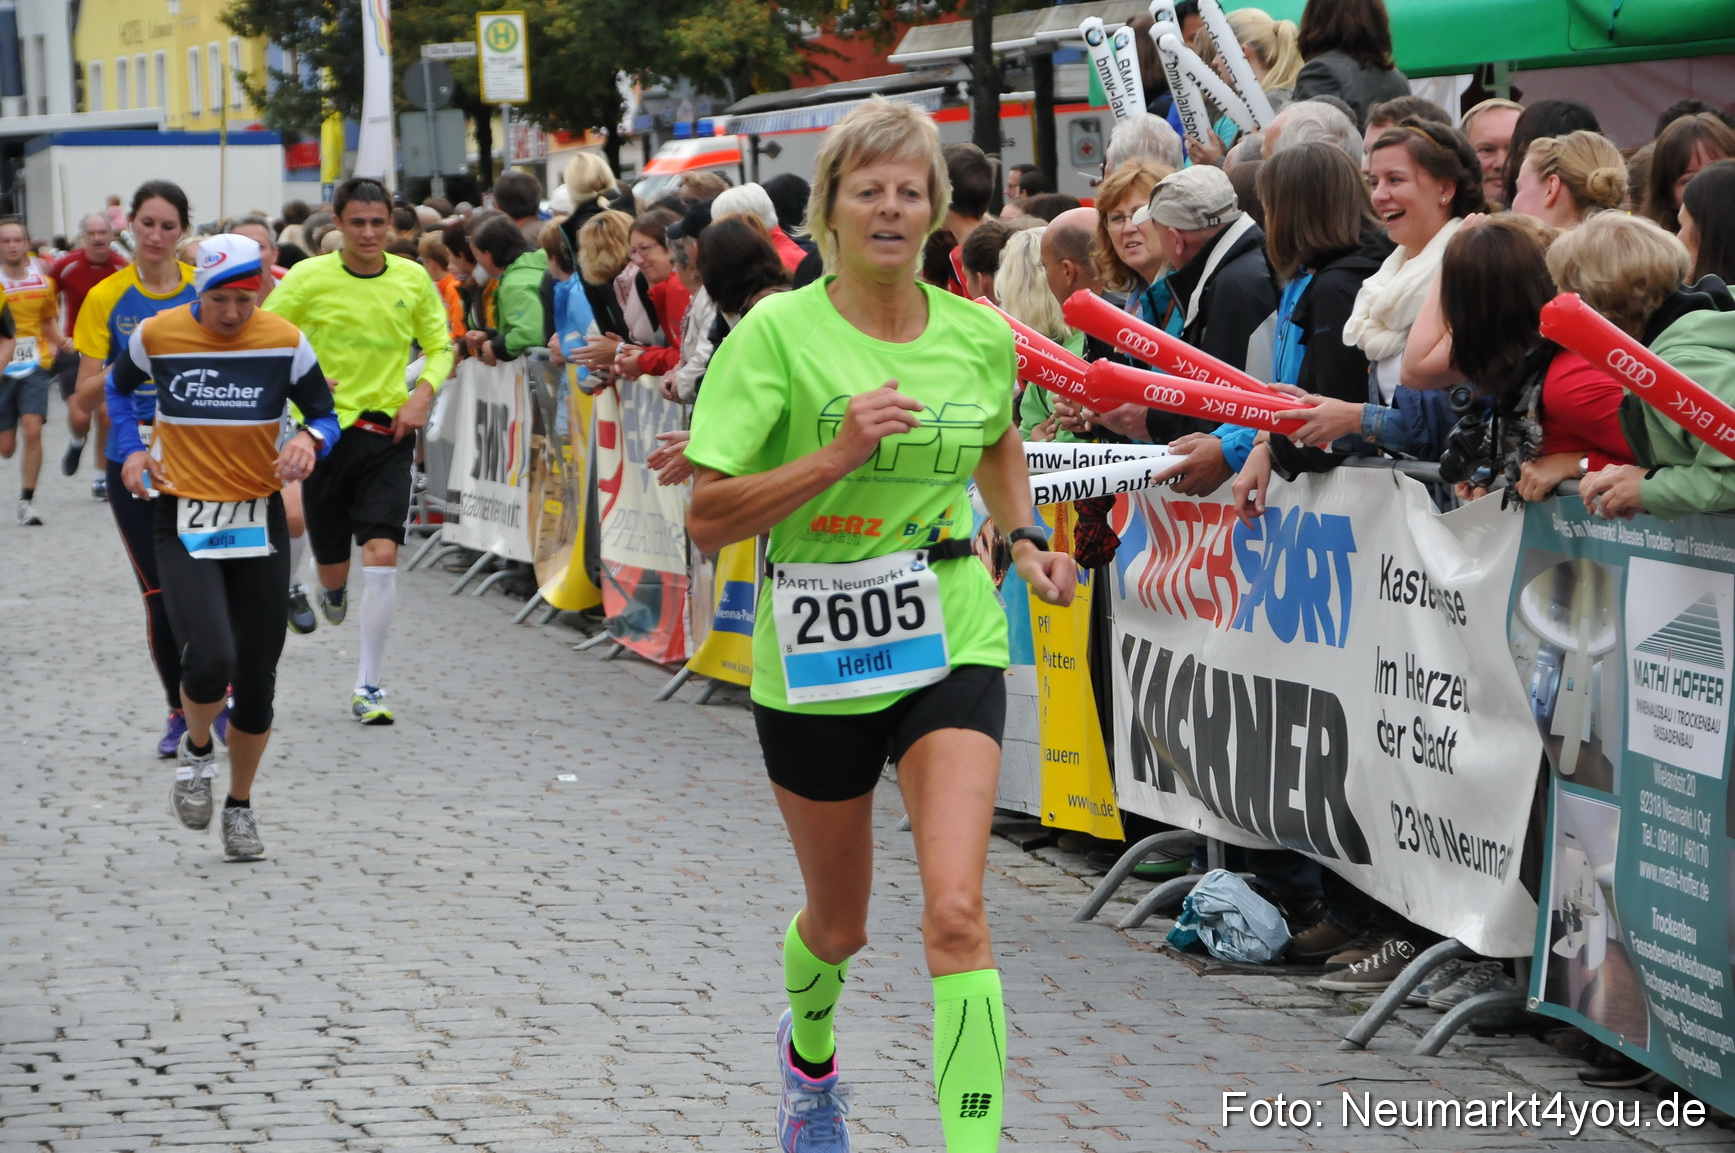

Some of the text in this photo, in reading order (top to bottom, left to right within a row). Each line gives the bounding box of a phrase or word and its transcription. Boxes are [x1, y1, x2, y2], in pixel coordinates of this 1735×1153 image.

[1096, 56, 1128, 118] bmw-lau
[183, 378, 264, 399] Fischer
[1036, 366, 1067, 389] BKK
[191, 399, 258, 408] AUTOMOBILE
[1200, 396, 1280, 426] BKK Audi
[1667, 391, 1715, 429] BKK
[1034, 478, 1095, 506] BMW
[777, 567, 905, 592] PARTL Neumarkt
[1136, 491, 1358, 650] INTERSPORT
[792, 579, 926, 647] 2605
[837, 654, 893, 678] Heidi
[1633, 658, 1725, 707] MATHI HOFFER
[1678, 709, 1722, 735] TROCKENBAU
[1377, 708, 1459, 775] der Stadt
[1653, 723, 1695, 750] FASSADENBAU
[1046, 748, 1081, 766] auern
[1651, 906, 1697, 946] Trockenbau
[1629, 930, 1725, 991] Fassadenverkleidungen
[960, 1110, 988, 1119] cep
